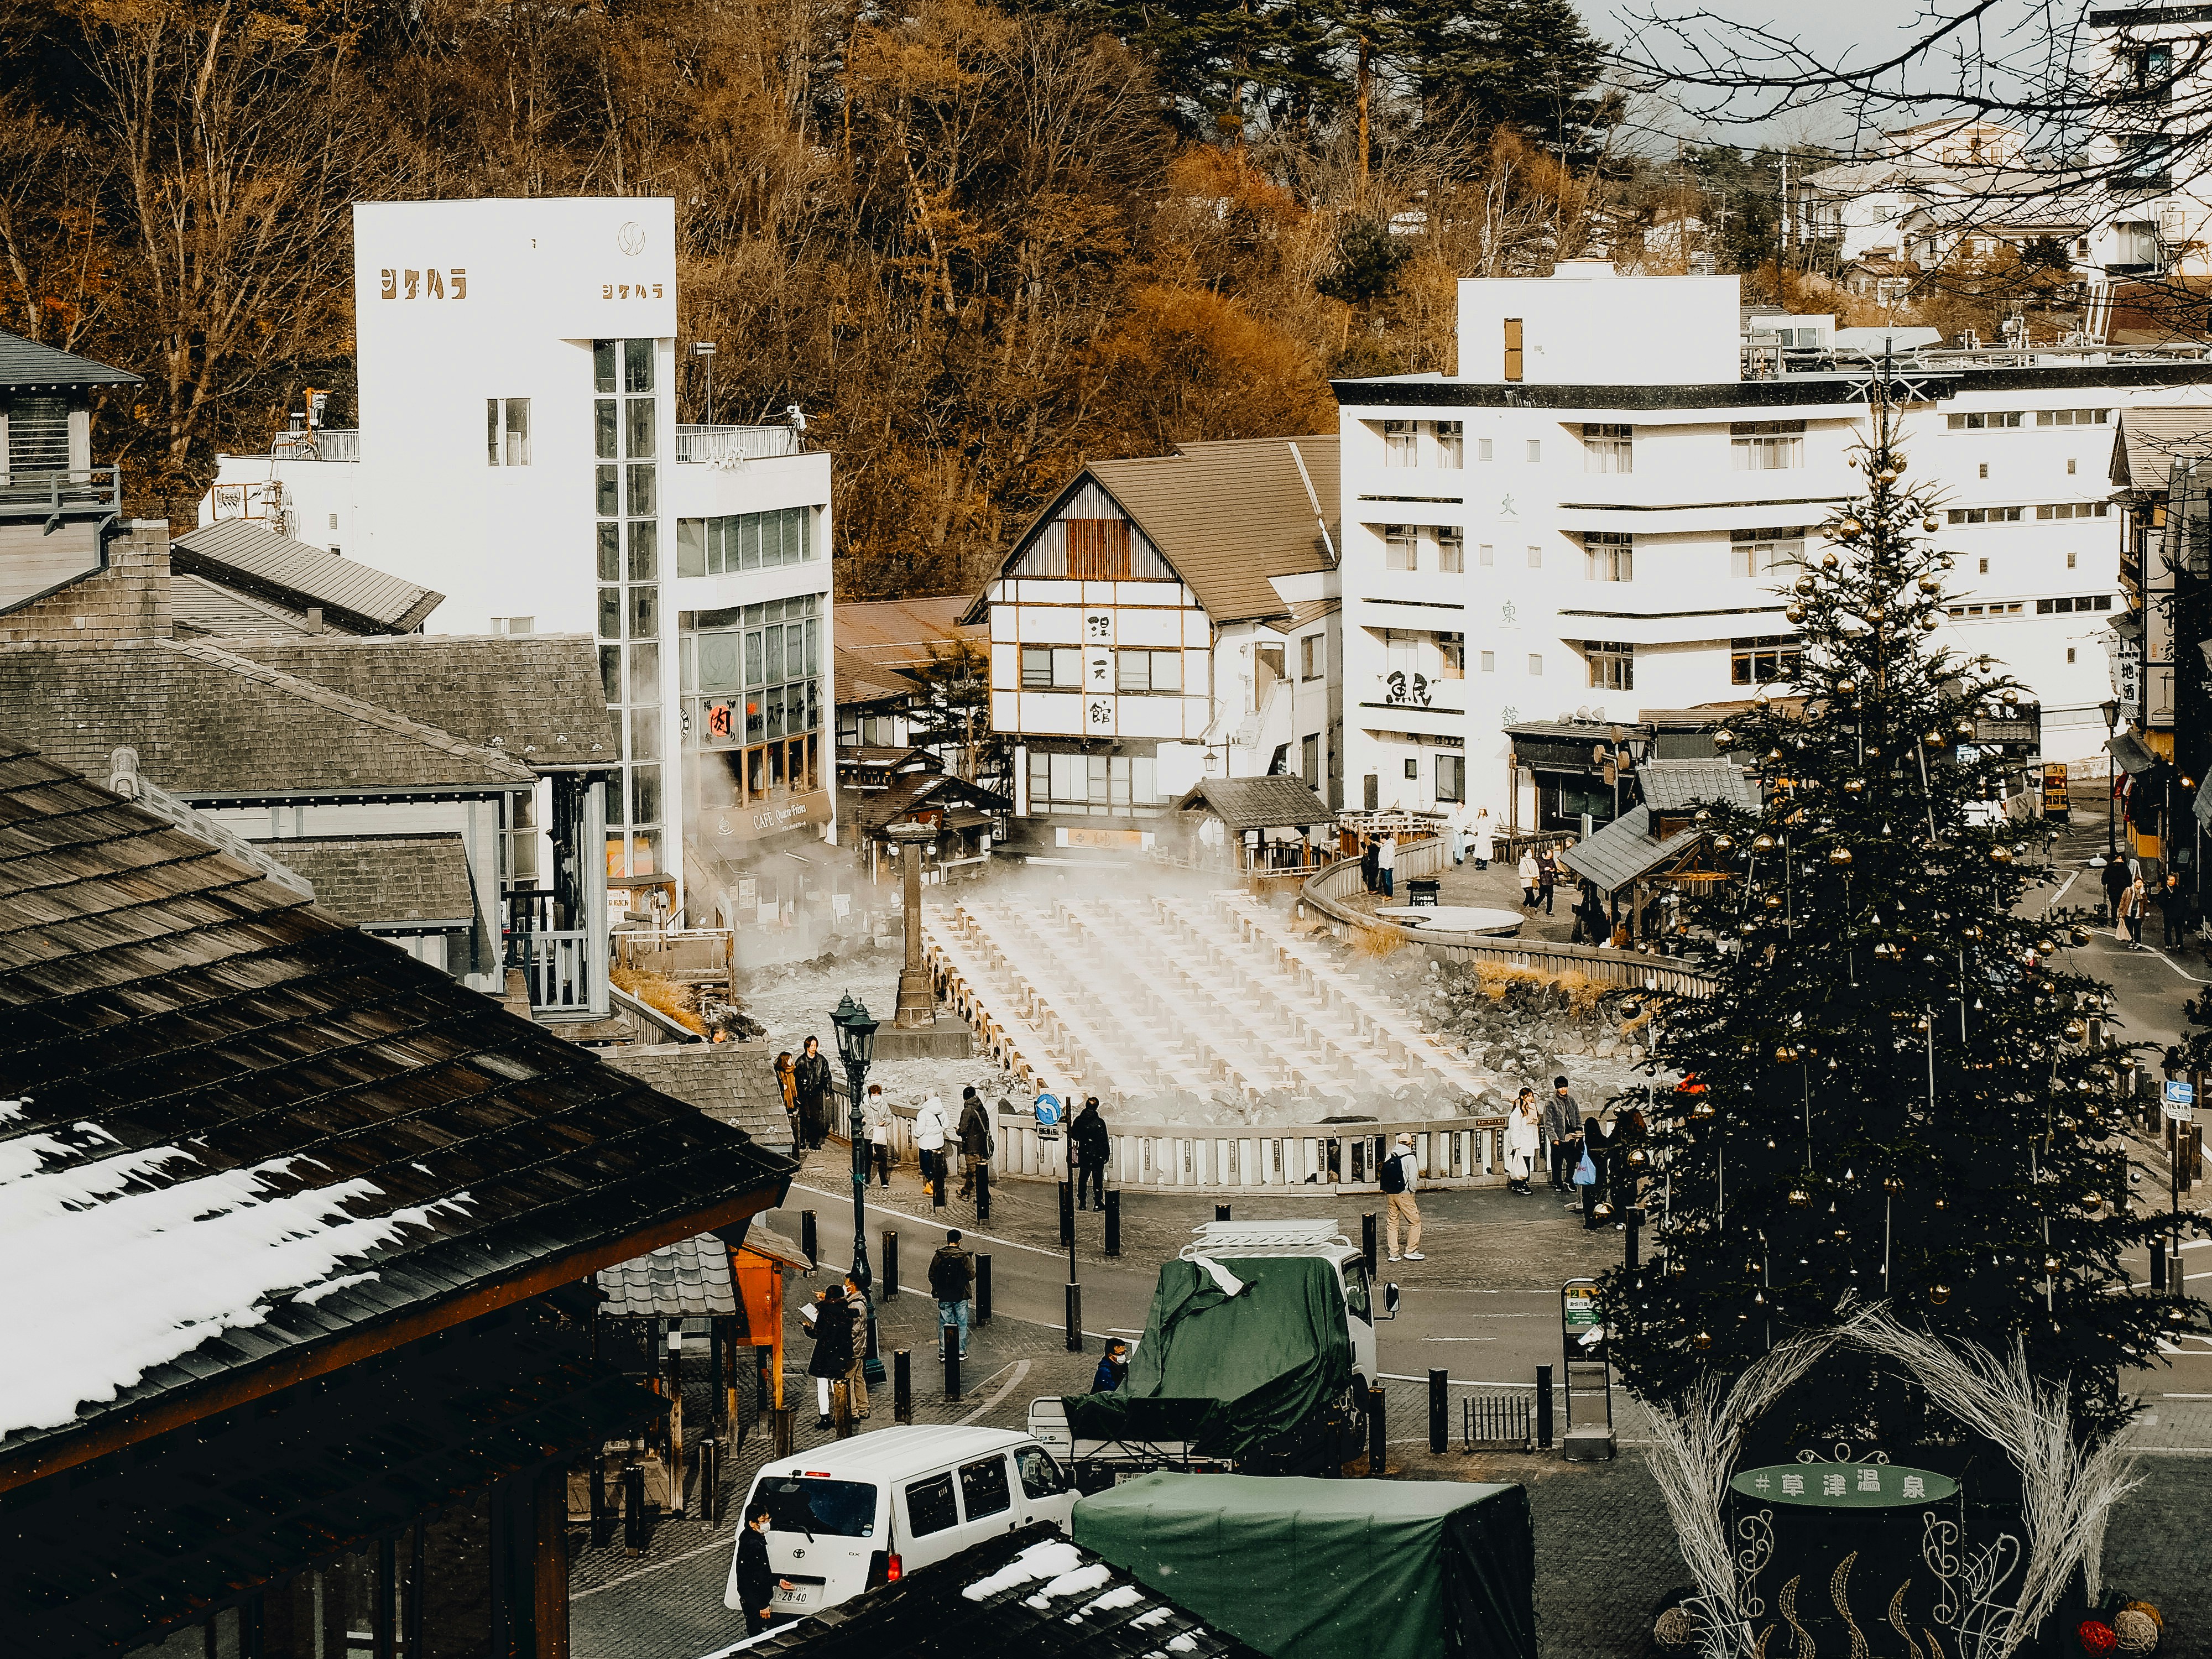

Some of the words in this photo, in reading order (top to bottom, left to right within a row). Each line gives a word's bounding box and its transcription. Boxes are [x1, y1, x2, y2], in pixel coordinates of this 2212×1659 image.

[381, 268, 466, 300] シゲハラ
[1386, 670, 1432, 707] 魚民
[2121, 662, 2135, 701] 地酒
[710, 707, 731, 735] 肉
[753, 807, 774, 830] CAFÉ
[781, 1592, 807, 1602] 28-40
